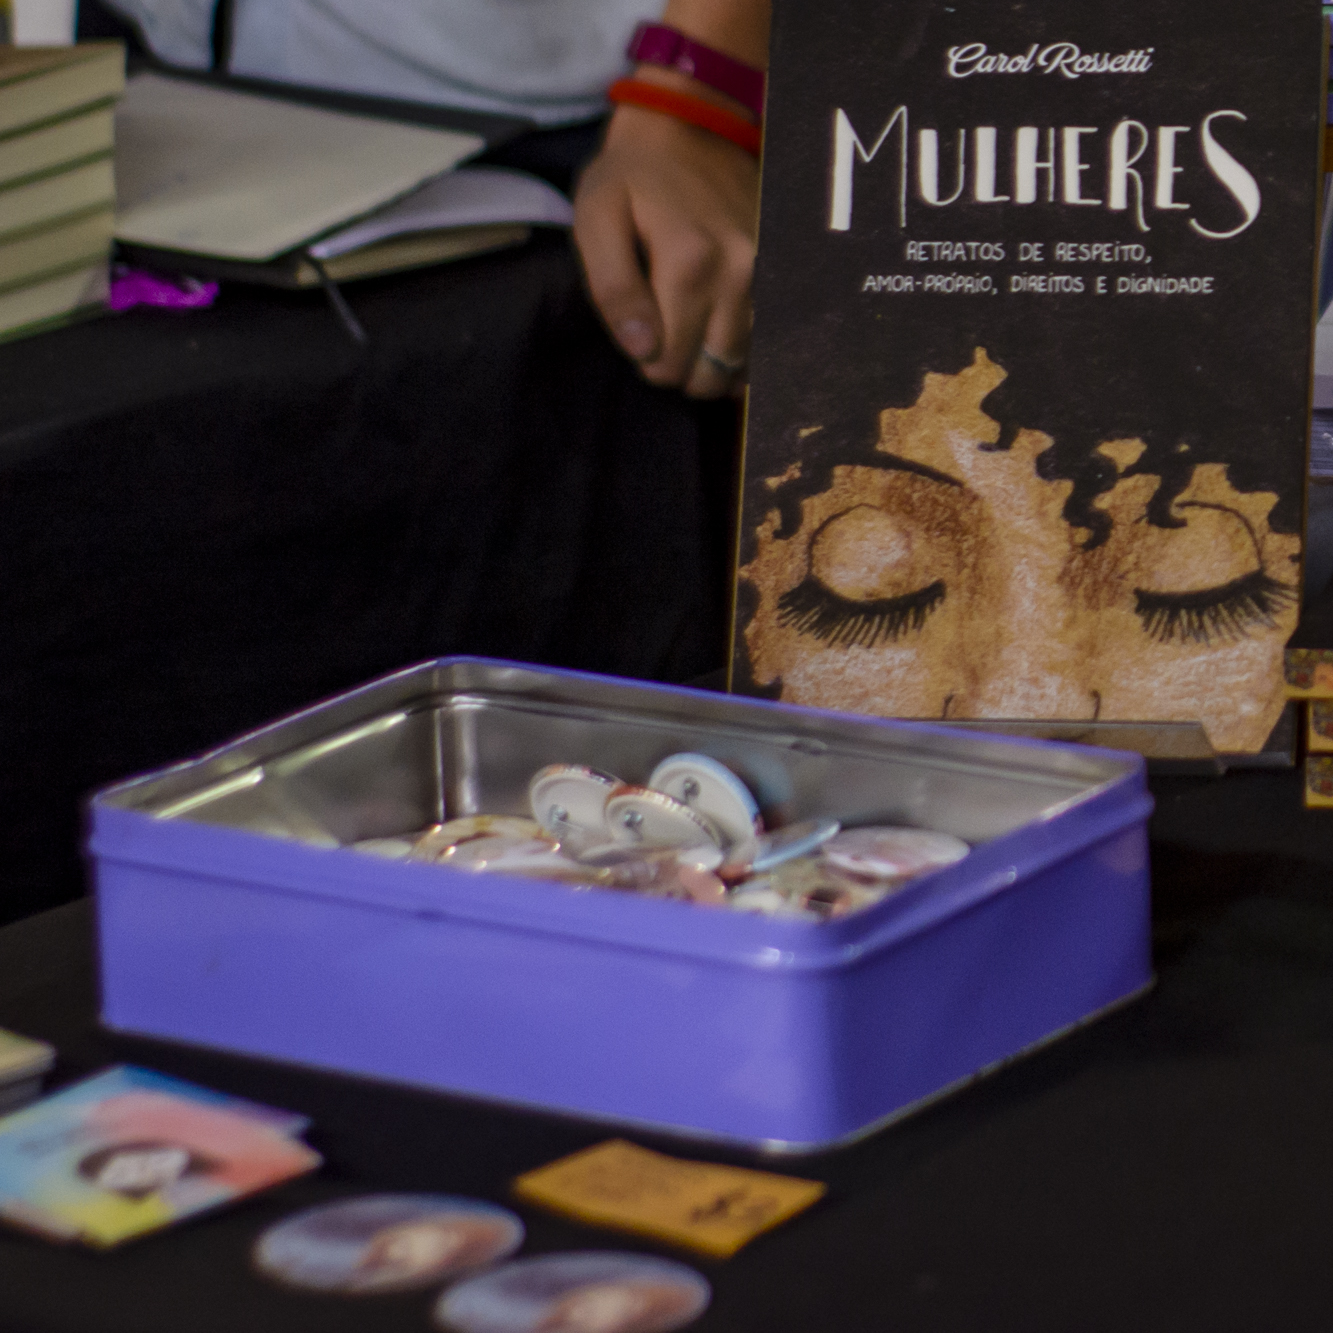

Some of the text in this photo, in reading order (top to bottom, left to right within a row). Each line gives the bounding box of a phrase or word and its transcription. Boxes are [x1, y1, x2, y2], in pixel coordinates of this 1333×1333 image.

[947, 42, 1155, 79] Carol Rossetti
[906, 240, 1152, 264] RETRATOS DE RESPEITO,
[863, 271, 1214, 295] AMOR-PRÓPRIO, DIREITOS E DIGNIDADE
